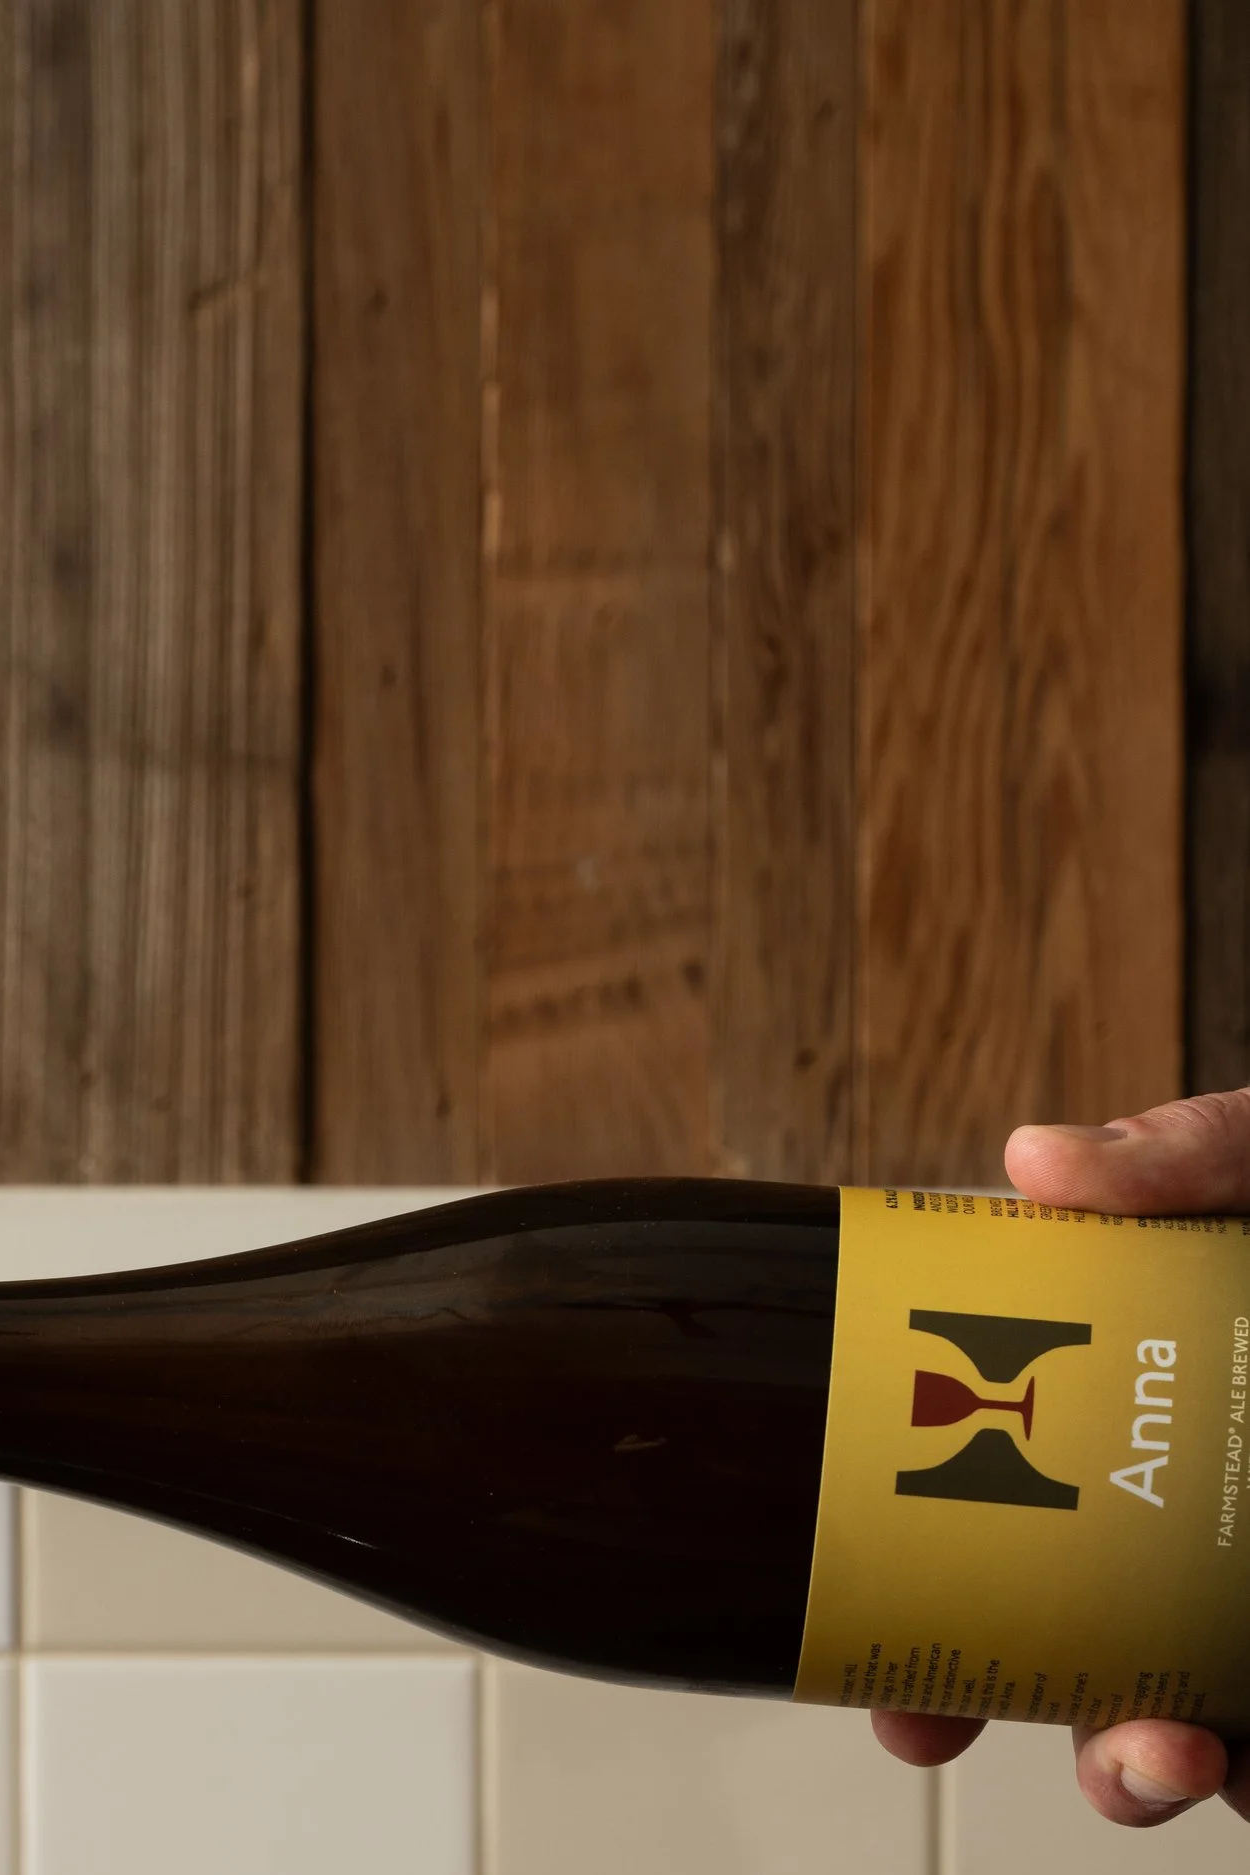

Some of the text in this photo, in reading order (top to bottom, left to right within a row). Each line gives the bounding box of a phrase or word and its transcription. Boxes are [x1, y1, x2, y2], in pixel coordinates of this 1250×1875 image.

[961, 1203, 976, 1215] OUR
[1006, 1207, 1020, 1219] HILL
[1022, 1210, 1036, 1220] 403
[1231, 1315, 1250, 1386] BREWED
[1229, 1389, 1247, 1424] ALE
[1108, 1338, 1177, 1509] Anna
[870, 1643, 881, 1660] was
[904, 1647, 921, 1670] from
[864, 1661, 879, 1677] that
[882, 1662, 897, 1676] her
[922, 1642, 942, 1682] American
[943, 1649, 962, 1690] distinctive
[985, 1659, 1000, 1675] the
[843, 1664, 858, 1678] Hill
[1033, 1672, 1048, 1682] of
[1177, 1671, 1191, 1688] and
[862, 1677, 875, 1692] land
[902, 1670, 918, 1693] crafted
[1072, 1672, 1090, 1693] one's
[1132, 1671, 1154, 1707] engaging
